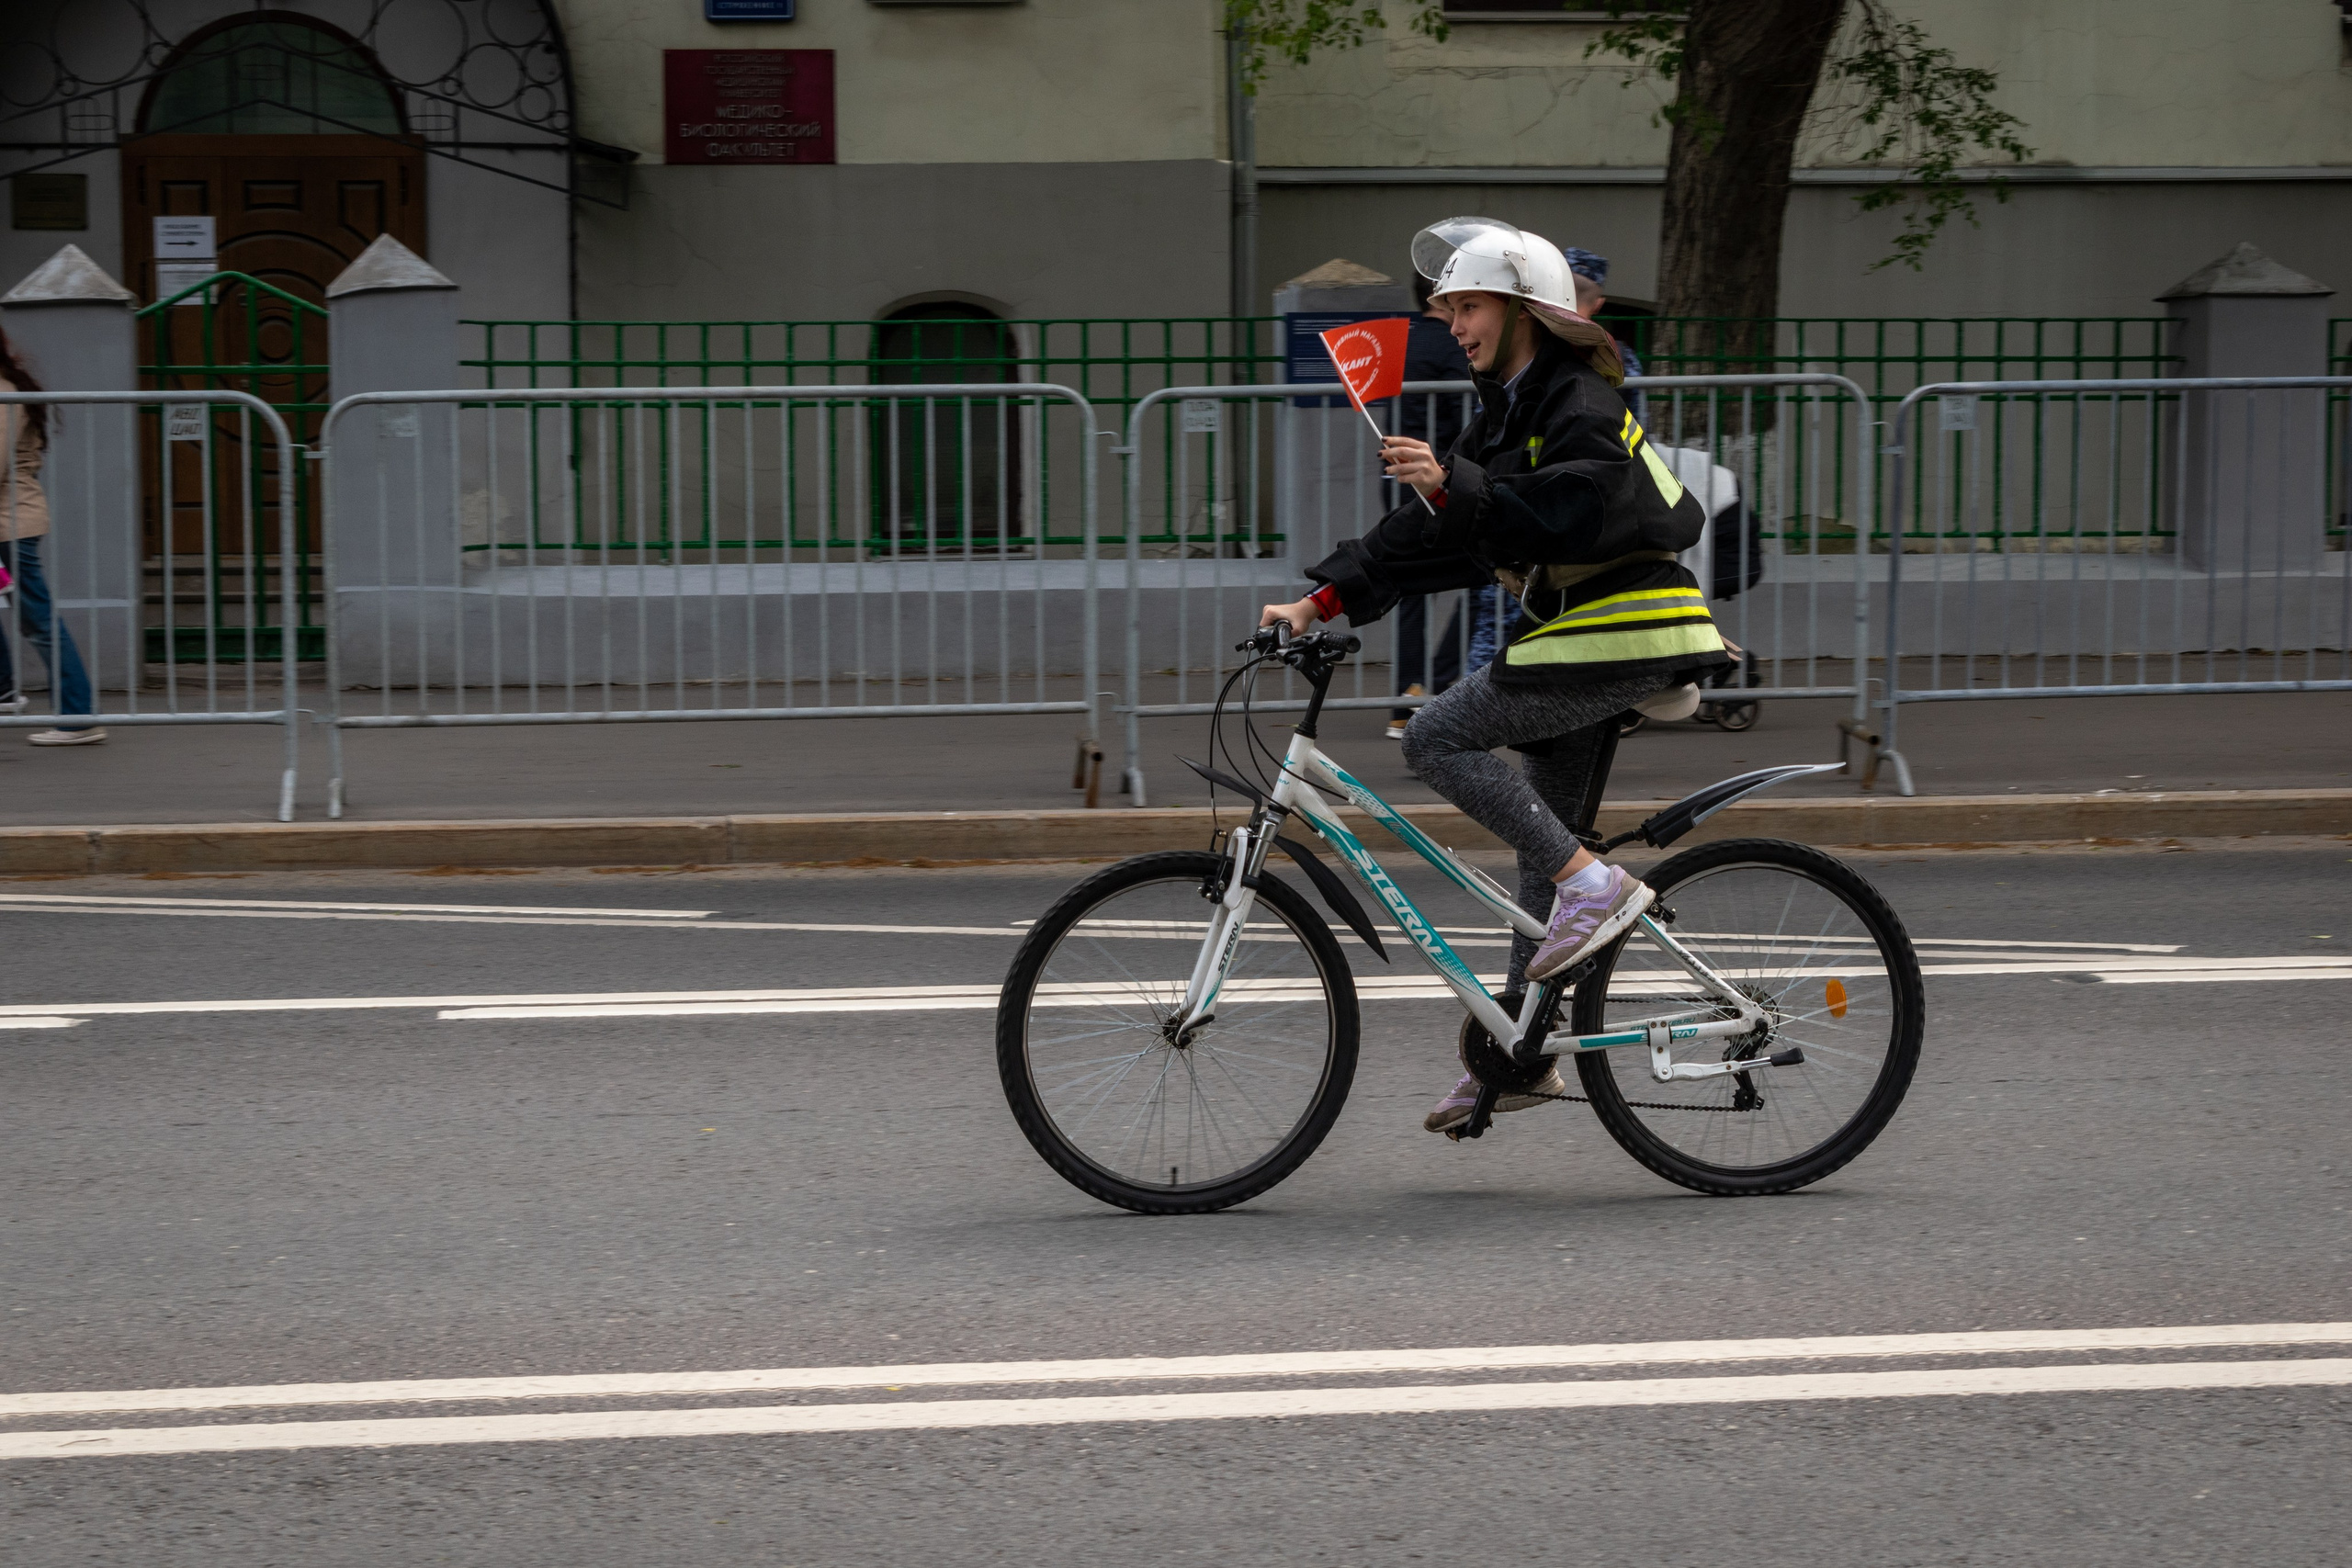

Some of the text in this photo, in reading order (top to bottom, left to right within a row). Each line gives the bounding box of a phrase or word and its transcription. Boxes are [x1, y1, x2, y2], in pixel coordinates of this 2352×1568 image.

[715, 104, 794, 118] МЕДИКО-
[679, 121, 821, 138] БИОЛОГИЧЕСКИЙ
[706, 142, 797, 157] ФАКУЛЬТЕТ
[1342, 355, 1374, 373] КАНТ
[1354, 848, 1442, 958] STERN
[1570, 913, 1600, 935] N
[1218, 921, 1239, 974] STERN
[1640, 1029, 1697, 1042] SRN
